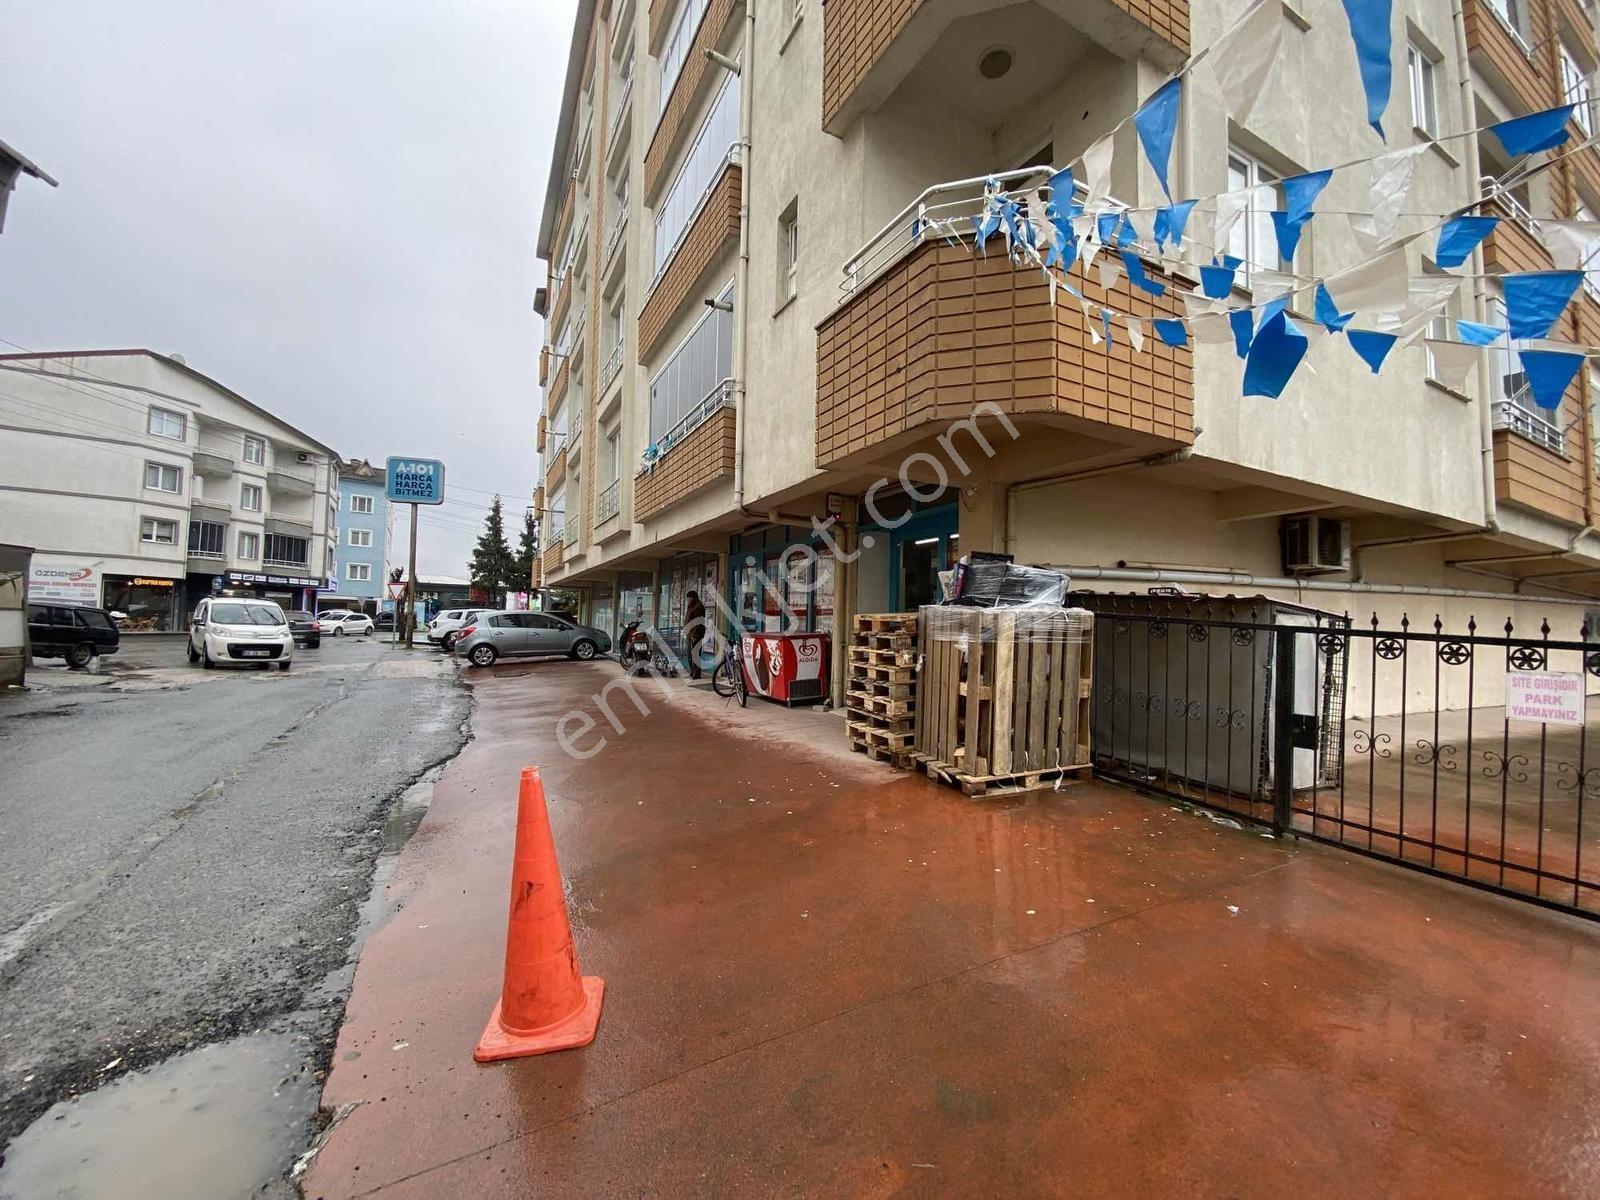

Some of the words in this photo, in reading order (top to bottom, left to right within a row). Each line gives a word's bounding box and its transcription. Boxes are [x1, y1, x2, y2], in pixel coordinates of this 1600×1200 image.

[396, 473, 433, 482] HARCA
[396, 481, 433, 490] HARCA
[1525, 693, 1562, 705] PARK
